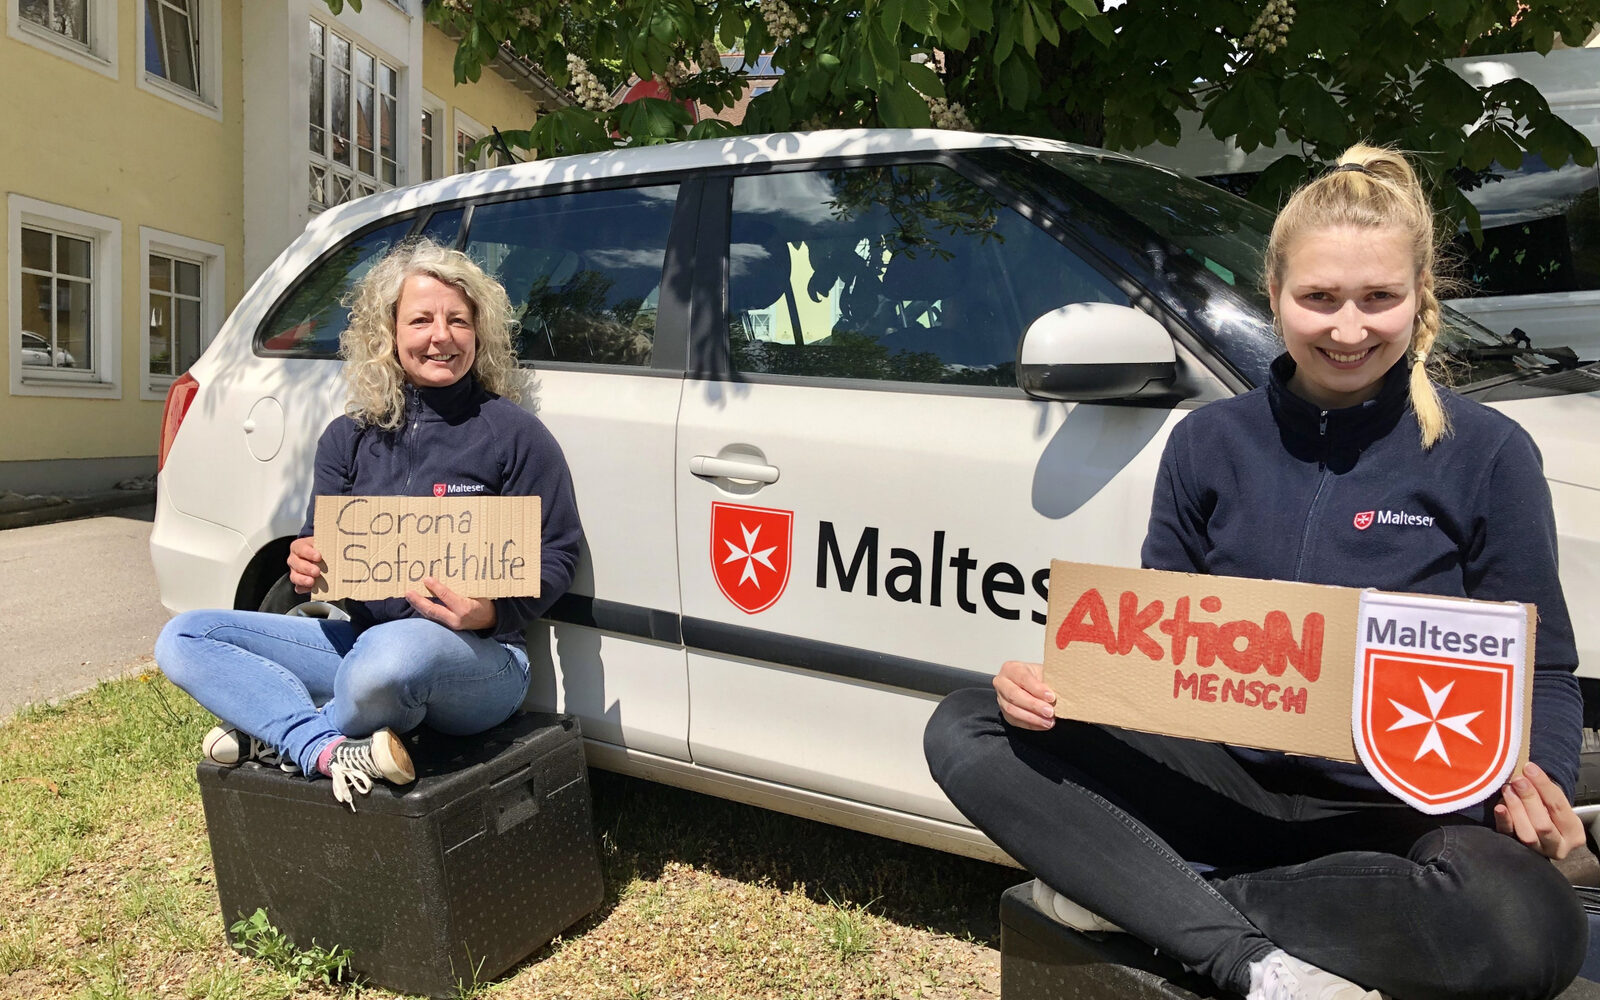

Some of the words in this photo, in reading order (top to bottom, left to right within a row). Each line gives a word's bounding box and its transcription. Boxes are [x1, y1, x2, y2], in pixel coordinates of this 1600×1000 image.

[447, 482, 485, 493] Malteser
[336, 499, 472, 536] Corona
[1377, 510, 1436, 527] Malteser
[341, 539, 525, 583] Soforthilfe
[1366, 616, 1515, 658] Malteser
[1173, 669, 1308, 714] MENSCH
